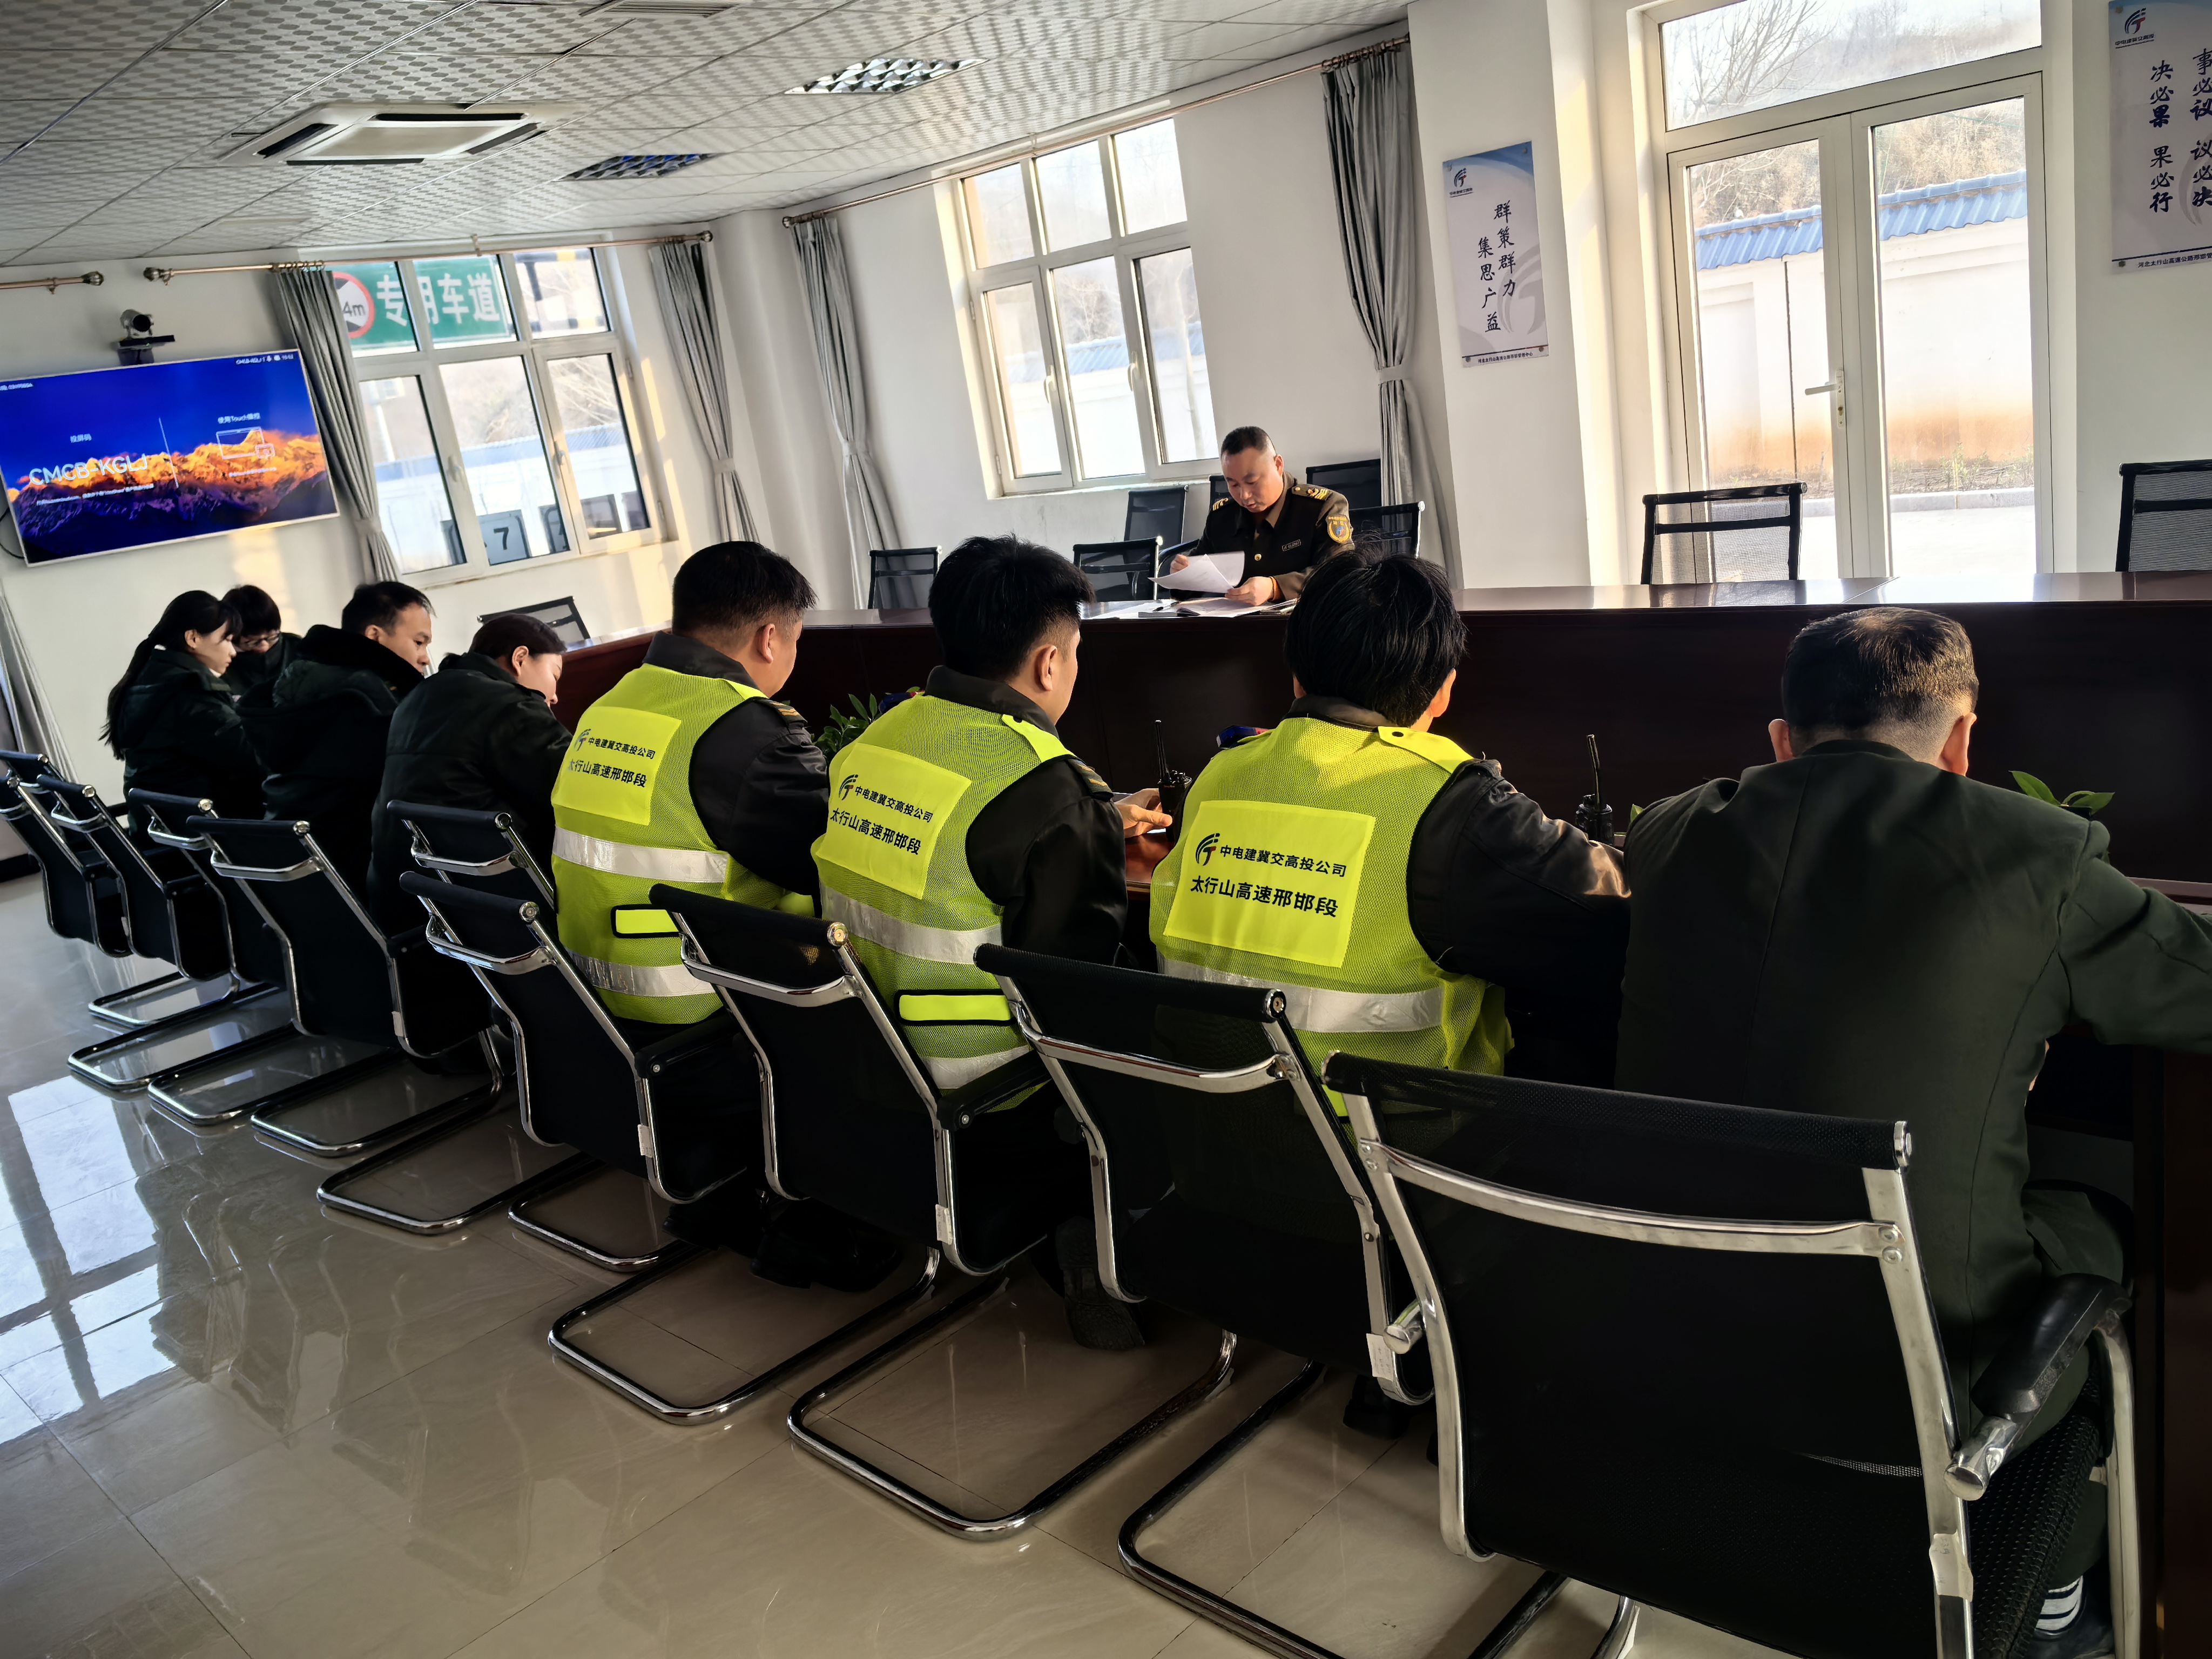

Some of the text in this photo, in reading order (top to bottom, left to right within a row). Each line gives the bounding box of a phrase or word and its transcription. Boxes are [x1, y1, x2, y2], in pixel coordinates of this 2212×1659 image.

[2149, 60, 2174, 213] 决必果 果必行
[2190, 49, 2212, 207] 事必议 议必决
[1493, 200, 1516, 297] 群策群力
[376, 272, 501, 327] 专用车道
[1478, 237, 1501, 333] 集思广益
[29, 453, 148, 485] CMCB-KGLJ
[588, 737, 656, 760] 中电建冀交高投公司
[568, 759, 647, 788] 太行山高速邢邯段
[854, 786, 933, 822] 中电建冀交高投公司
[830, 807, 921, 855] 太行山高速邢邯段
[1219, 845, 1347, 877] 中电建冀交高投公司
[1190, 875, 1338, 918] 太行山高速邢邯段
